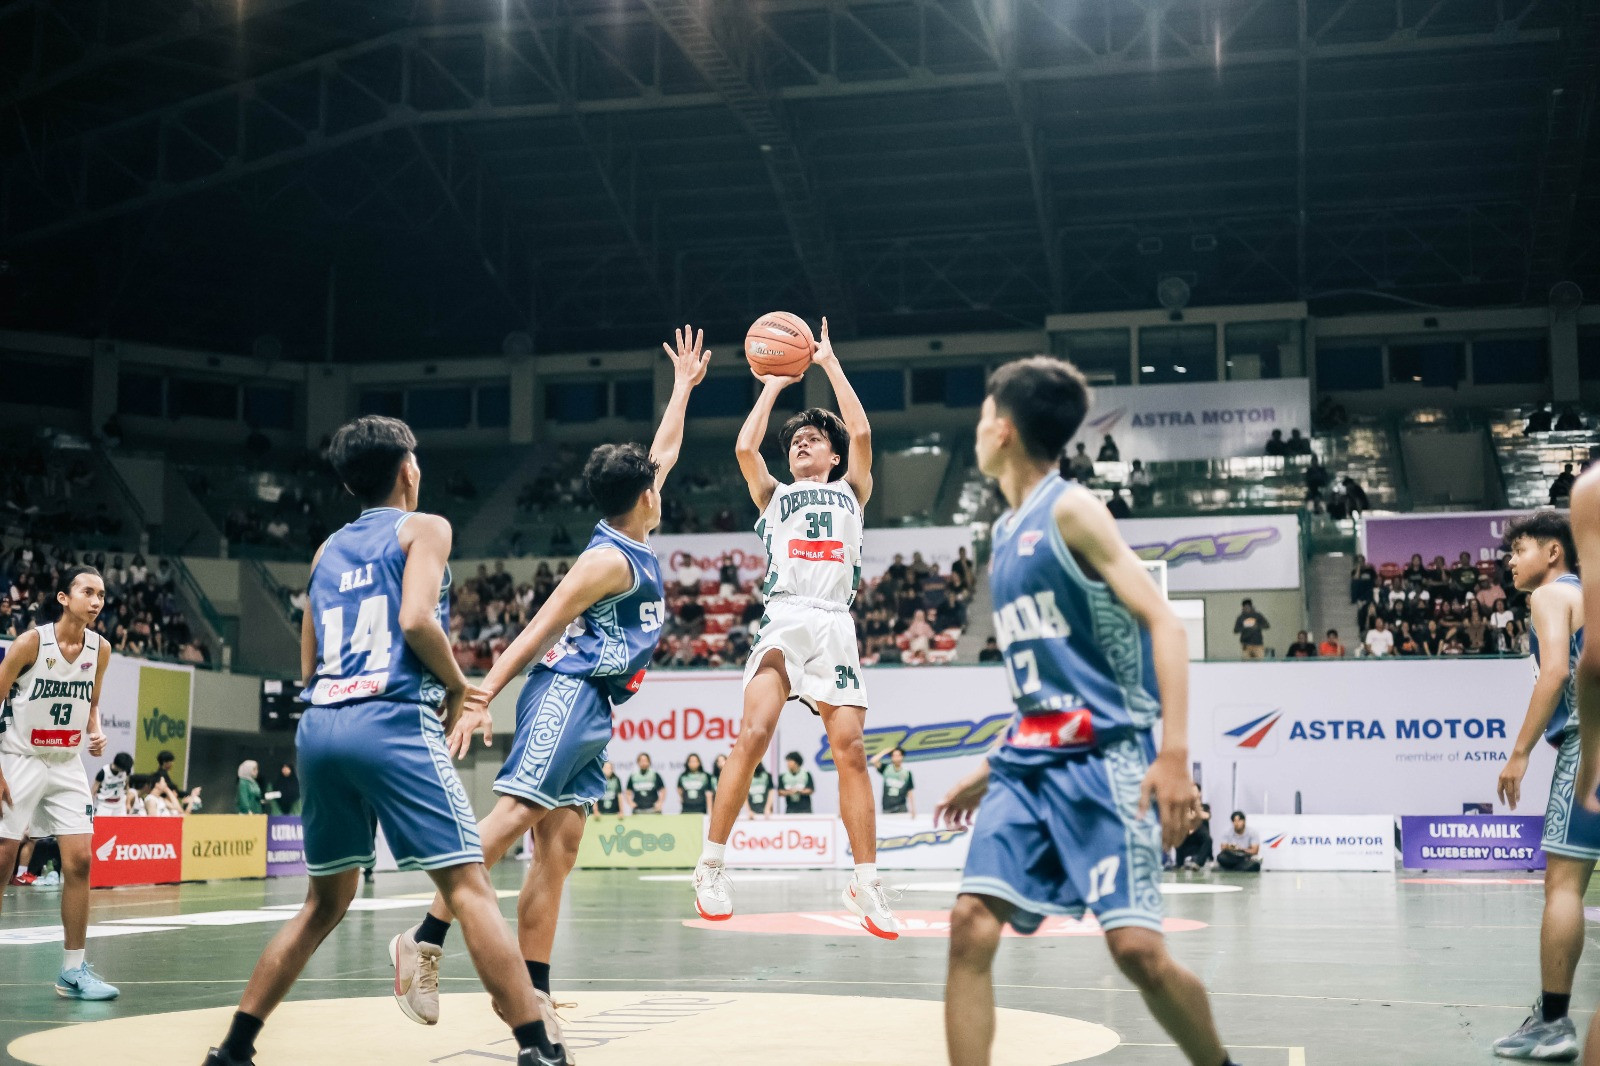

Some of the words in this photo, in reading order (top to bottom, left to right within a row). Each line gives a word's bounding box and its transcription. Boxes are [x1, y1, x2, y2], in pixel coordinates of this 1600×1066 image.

[1131, 411, 1196, 427] ASTRA
[1202, 407, 1276, 425] MOTOR
[779, 489, 855, 523] DEBRITTO
[805, 512, 833, 539] 34
[792, 548, 806, 556] One
[339, 562, 373, 593] ALI
[317, 594, 392, 676] 14
[835, 665, 860, 690] 34
[28, 677, 94, 703] DEBRITTO
[49, 703, 73, 726] 43
[612, 710, 676, 741] ood
[1290, 720, 1386, 740] ASTRA
[1396, 718, 1507, 739] MOTOR
[1395, 752, 1443, 763] member
[1448, 751, 1460, 762] of
[1464, 750, 1508, 762] ASTRA
[1291, 837, 1331, 846] ASTRA
[1336, 836, 1383, 846] MOTOR
[1429, 822, 1480, 839] ULTRA
[1481, 823, 1522, 839] MILK
[115, 843, 177, 861] HONDA
[192, 838, 254, 858] azarine
[1421, 846, 1490, 859] BLUEBERRY
[1493, 847, 1534, 859] BLAST
[1086, 854, 1121, 904] 17
